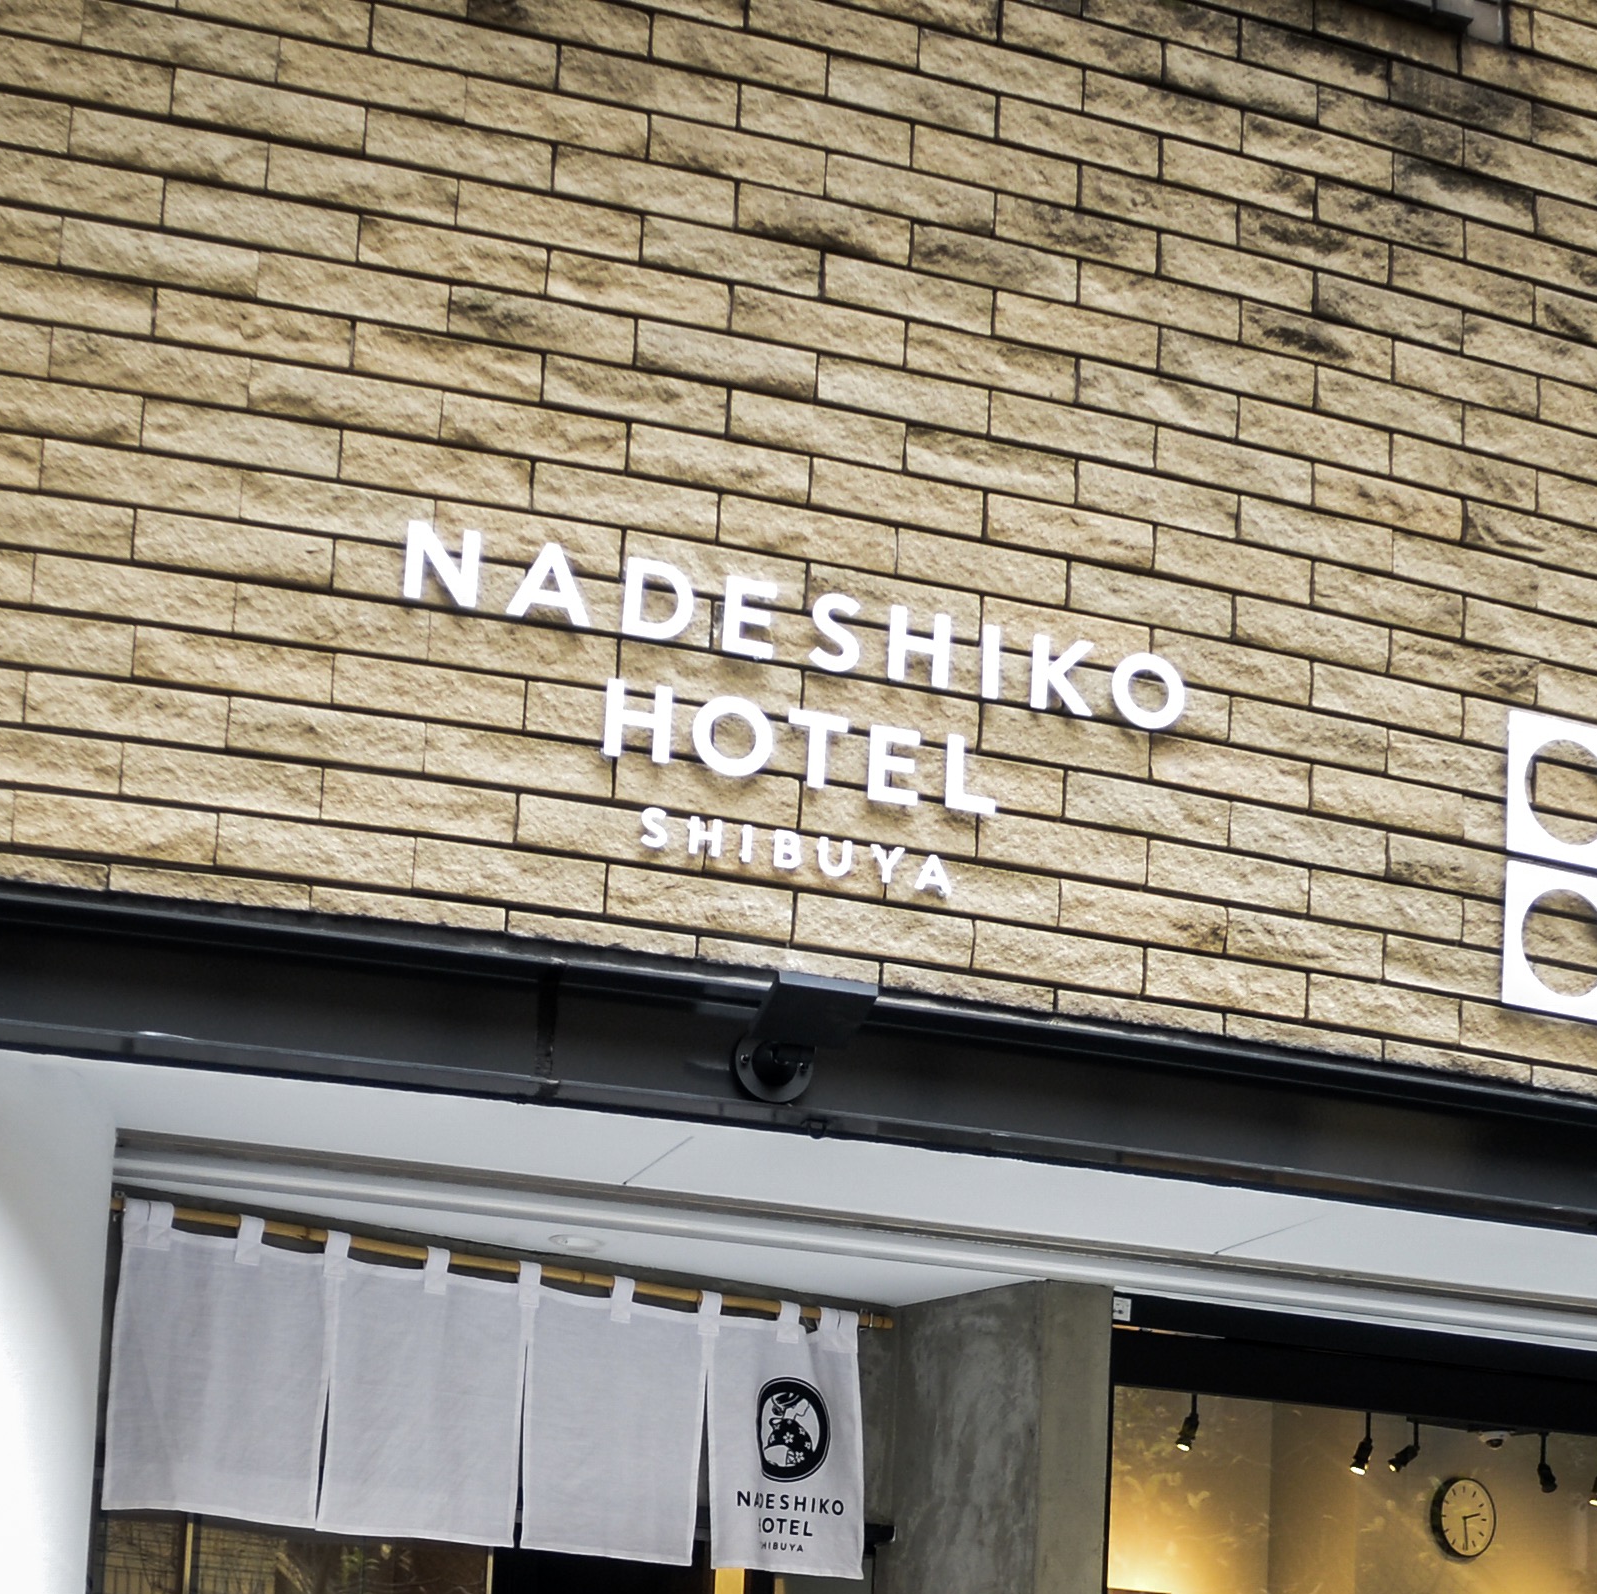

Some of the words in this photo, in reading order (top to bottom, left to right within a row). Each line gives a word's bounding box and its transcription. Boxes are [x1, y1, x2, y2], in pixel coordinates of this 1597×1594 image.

[404, 520, 1186, 729] NADESHIKO
[604, 678, 997, 816] HOTEL
[641, 807, 952, 897] SHIBUYA
